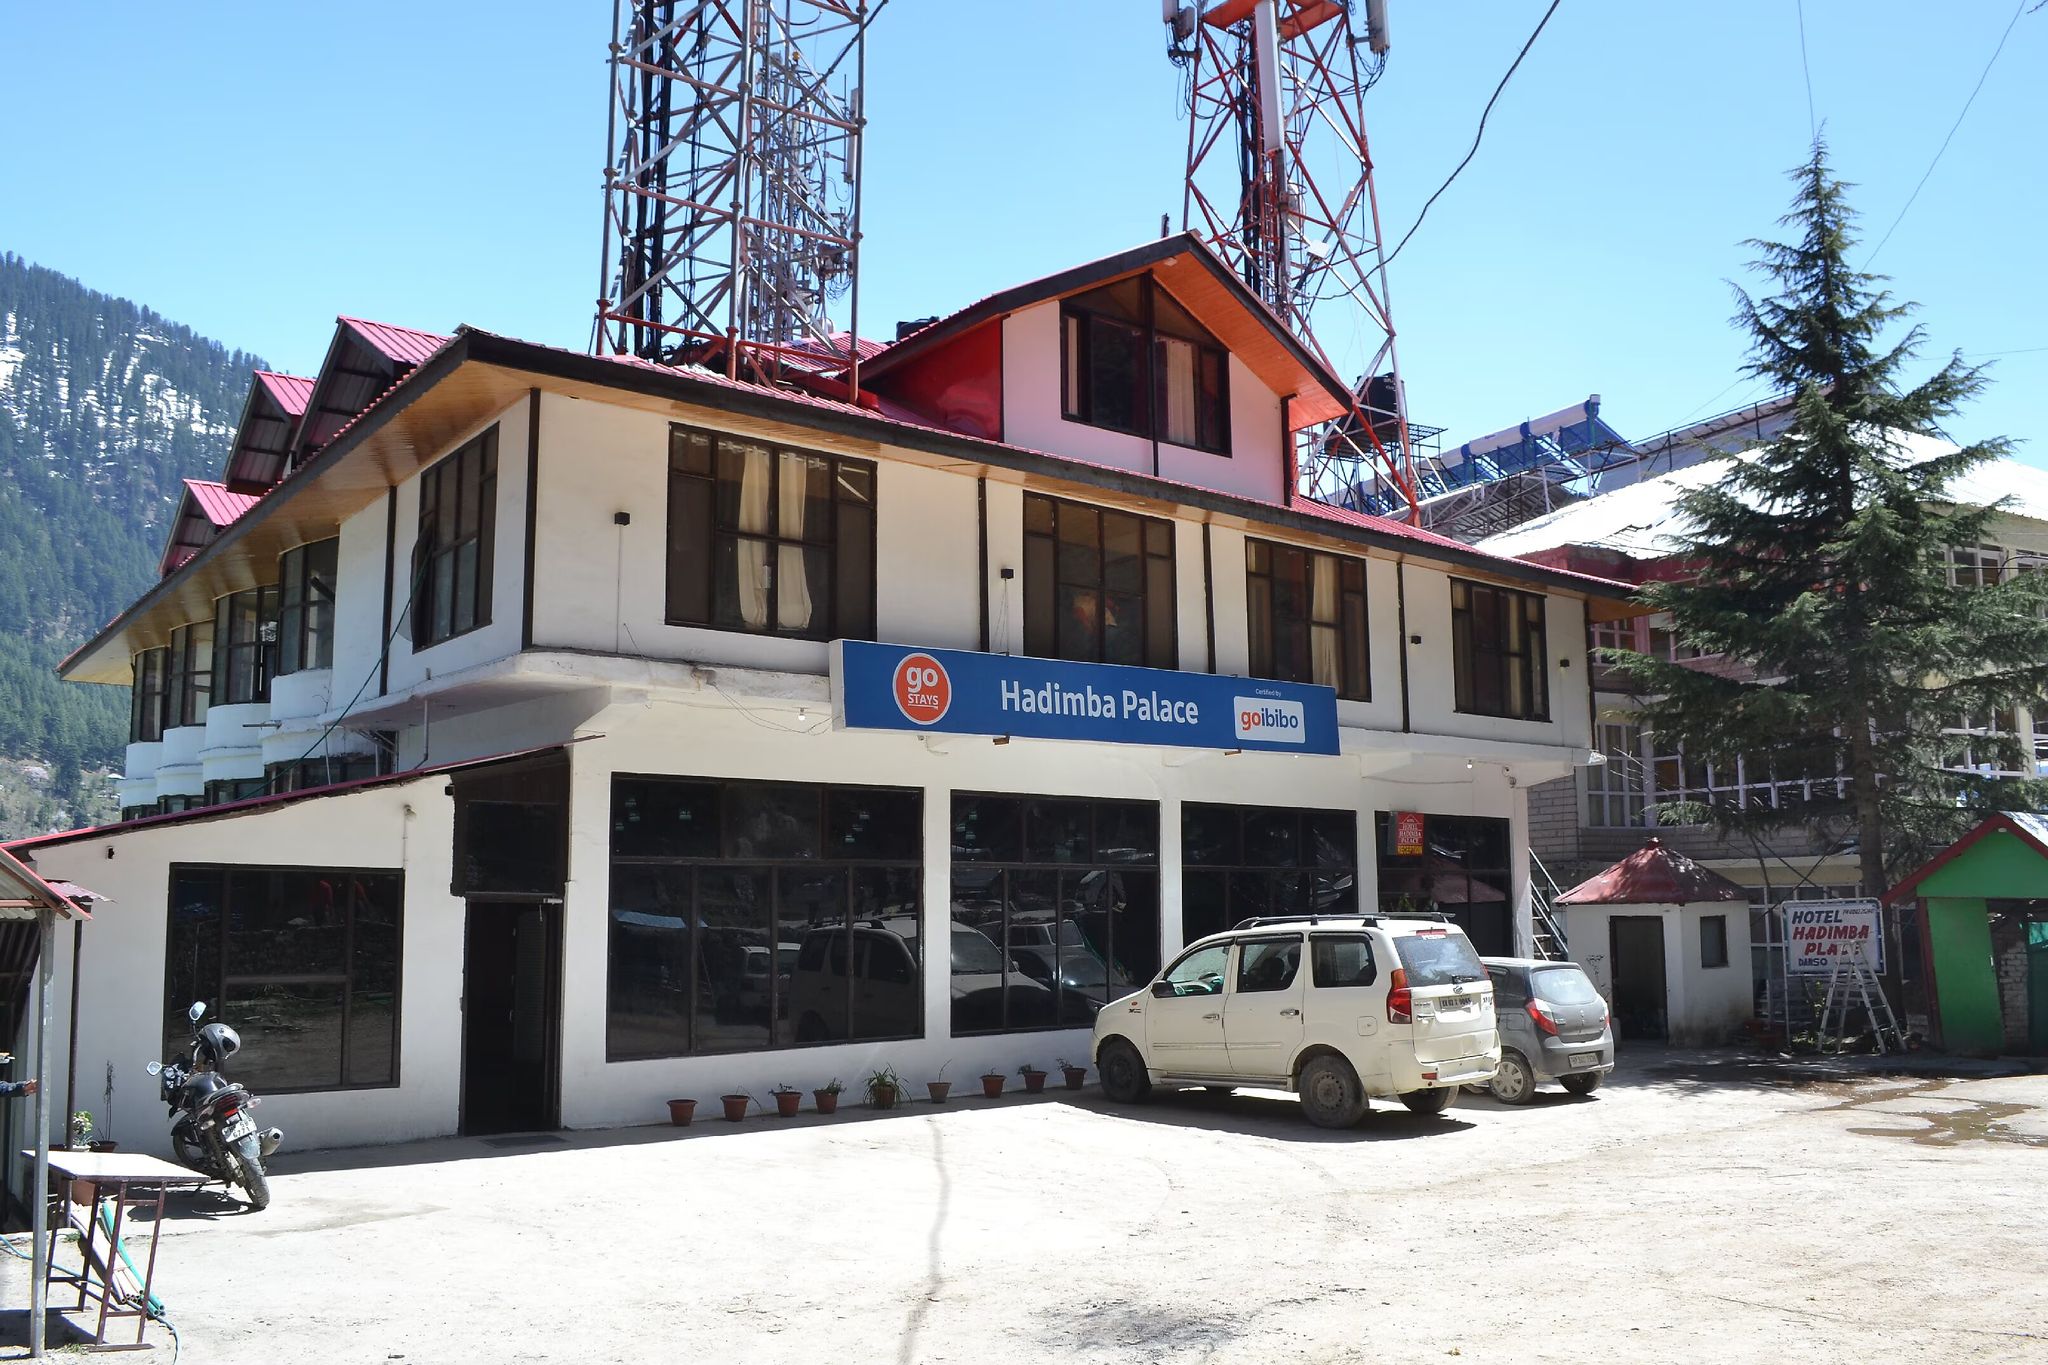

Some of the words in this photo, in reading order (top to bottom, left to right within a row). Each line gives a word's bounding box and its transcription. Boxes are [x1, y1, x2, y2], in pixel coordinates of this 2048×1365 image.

[906, 666, 939, 694] go
[907, 693, 939, 706] STAYS
[1255, 688, 1275, 696] Certified
[1275, 690, 1282, 698] by
[1001, 679, 1116, 719] Hadimba
[1122, 689, 1199, 724] Palace
[1241, 707, 1299, 731] goibibo
[1792, 909, 1842, 924] HOTEL
[1792, 925, 1870, 940] HADIMBA
